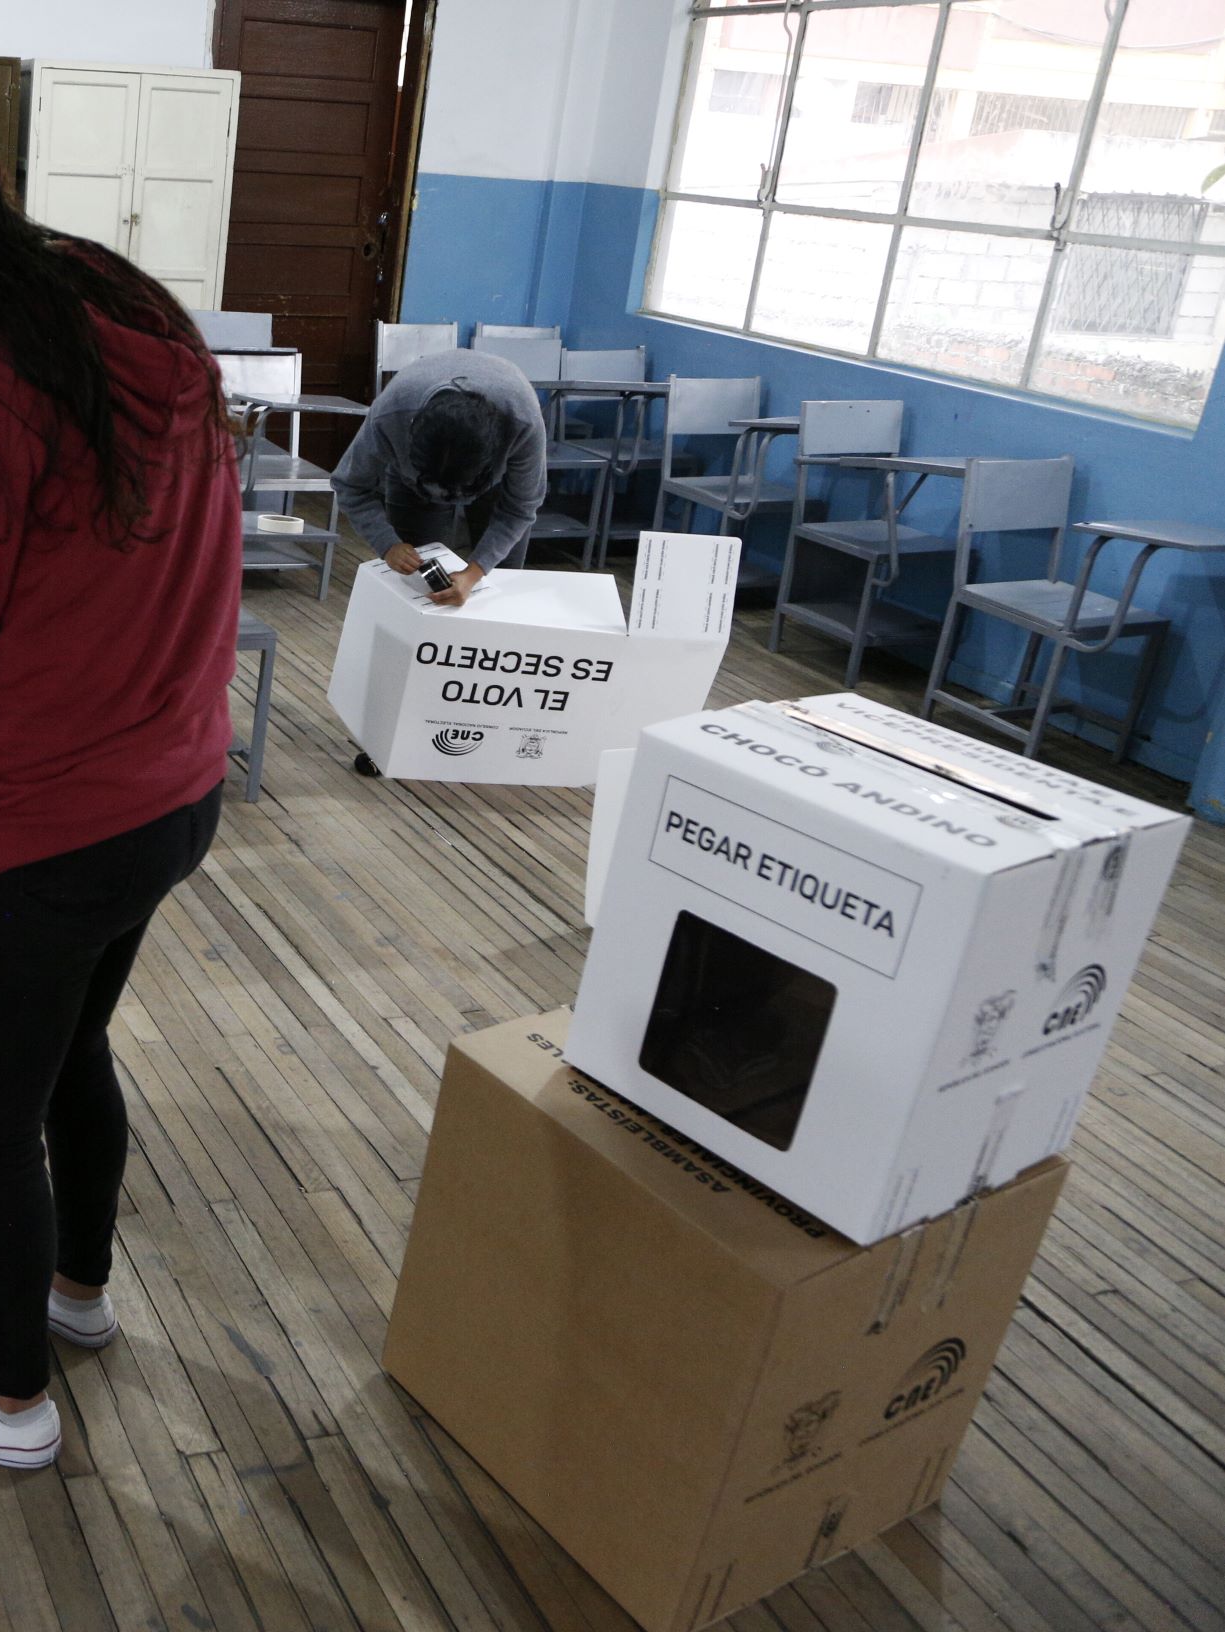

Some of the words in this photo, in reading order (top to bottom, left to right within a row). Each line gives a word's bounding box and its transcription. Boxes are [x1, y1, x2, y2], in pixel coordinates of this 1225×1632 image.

[415, 641, 565, 678] SECRETO
[570, 658, 614, 682] ES
[441, 680, 523, 708] VOTO
[534, 688, 570, 711] EL
[833, 781, 998, 848] ANDINO
[665, 810, 752, 871] PEGAR
[757, 853, 895, 938] ETIQUETA
